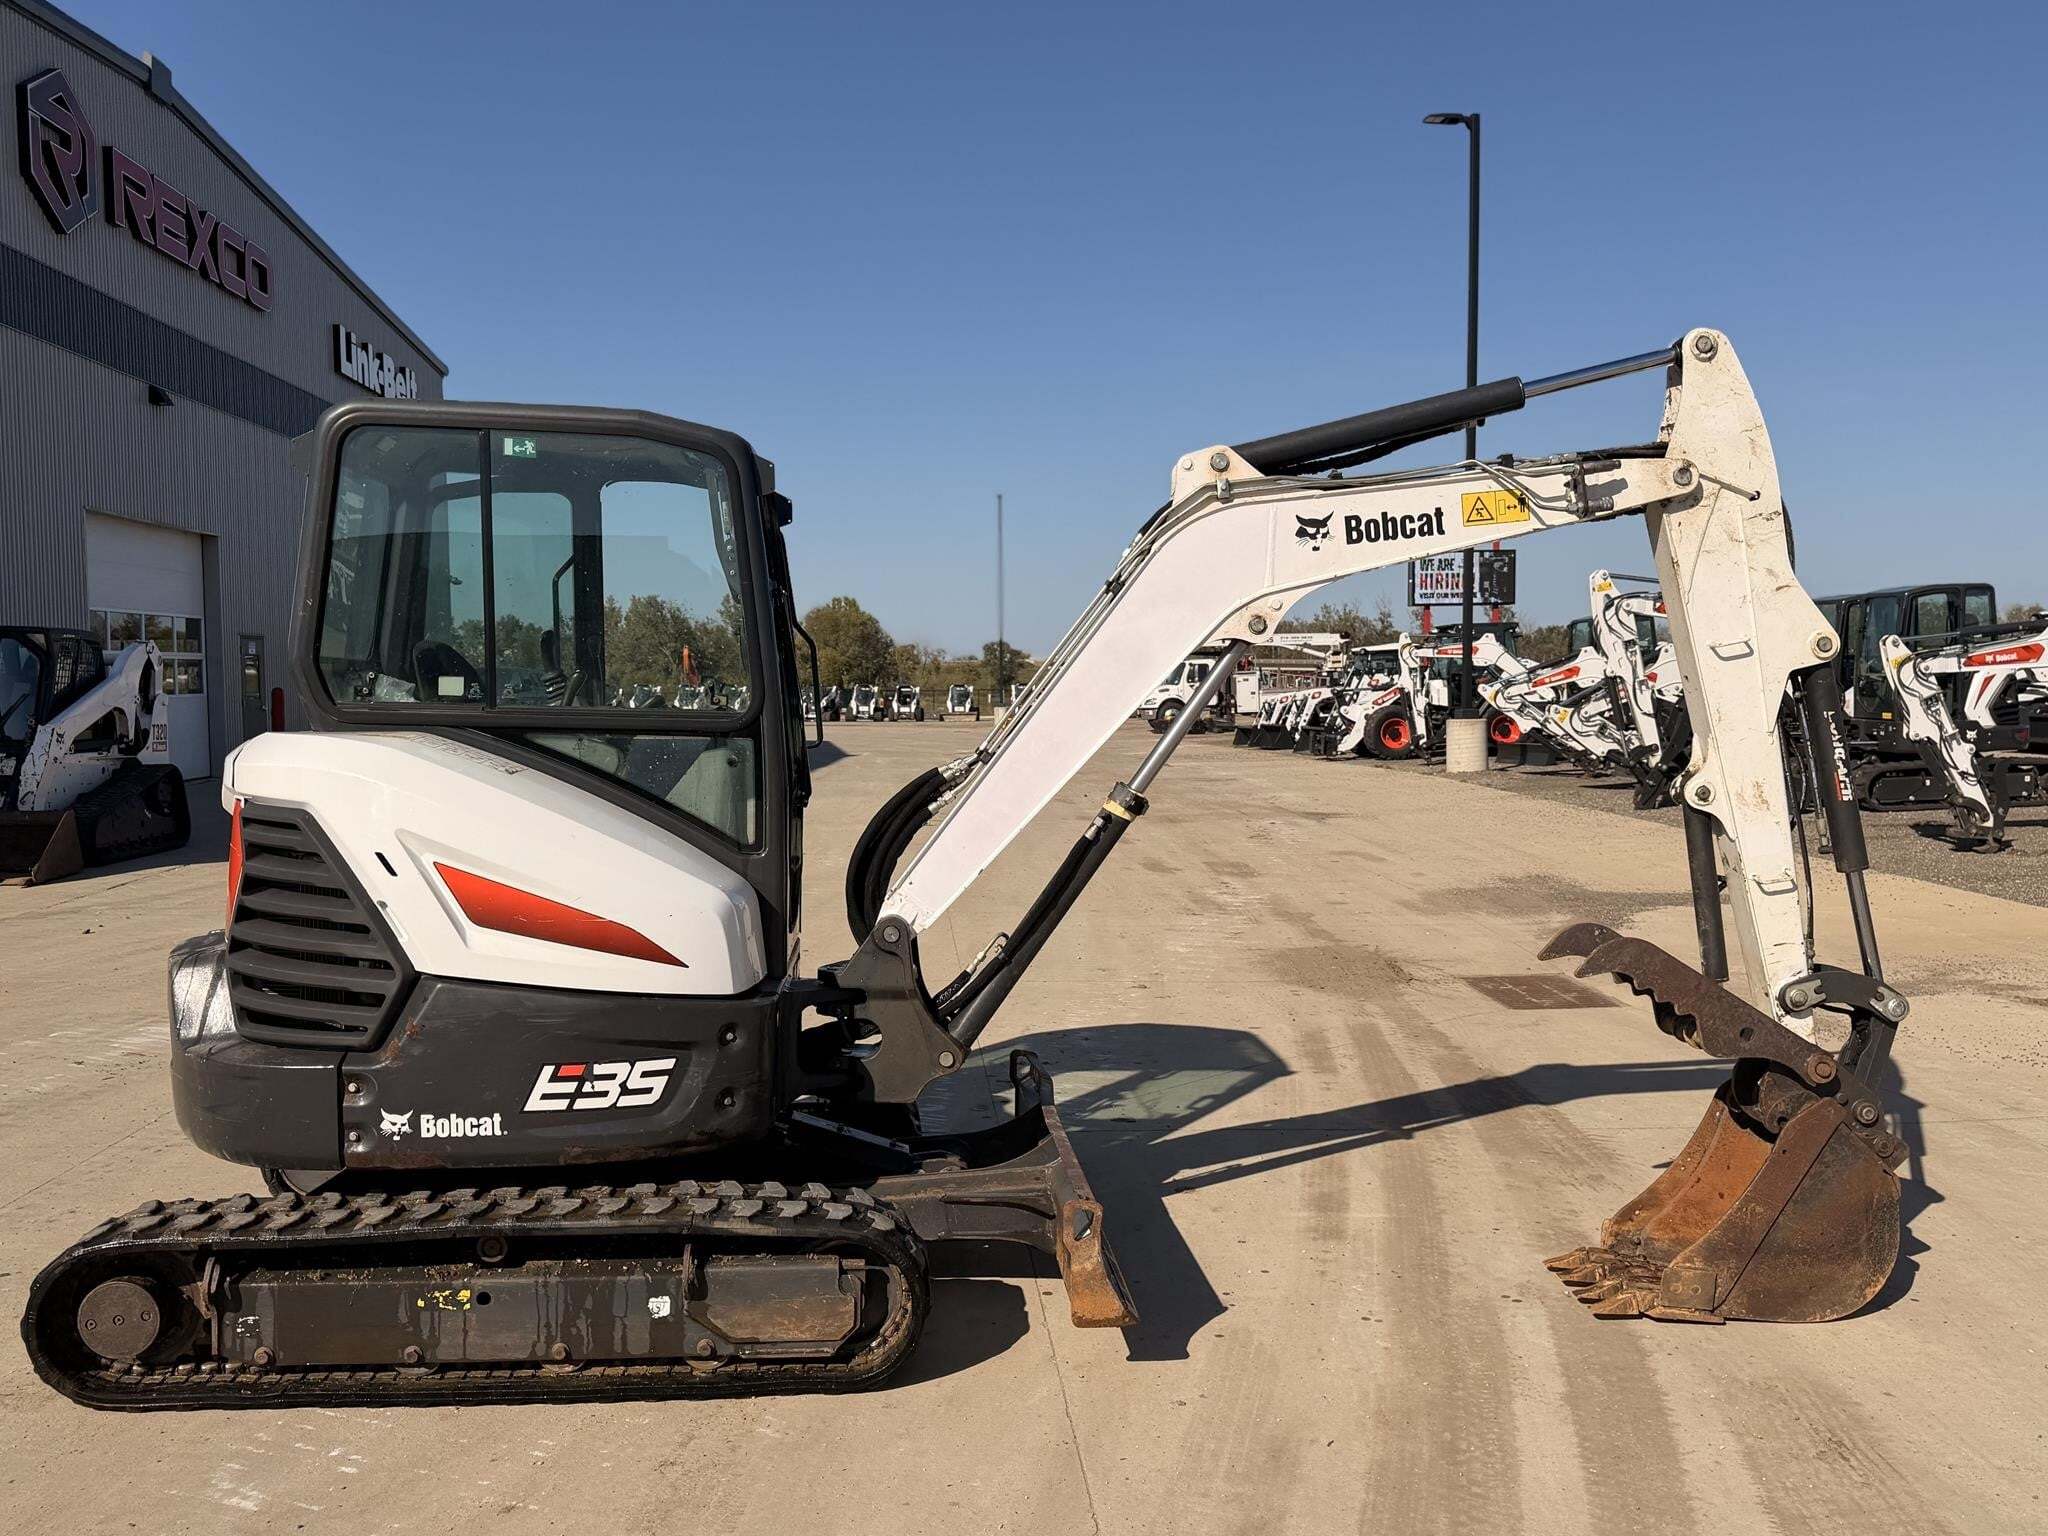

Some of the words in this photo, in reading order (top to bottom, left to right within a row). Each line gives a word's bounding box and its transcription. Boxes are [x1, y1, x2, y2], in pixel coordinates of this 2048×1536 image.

[104, 146, 274, 312] REXCO
[333, 323, 418, 400] Link-Belt
[1344, 506, 1446, 545] Bobcat
[1420, 558, 1435, 572] WE
[1437, 558, 1455, 572] ARE
[1420, 572, 1470, 591] HIRIN
[152, 724, 167, 740] T320
[522, 1058, 677, 1112] E35
[420, 1112, 502, 1138] Bobcat
